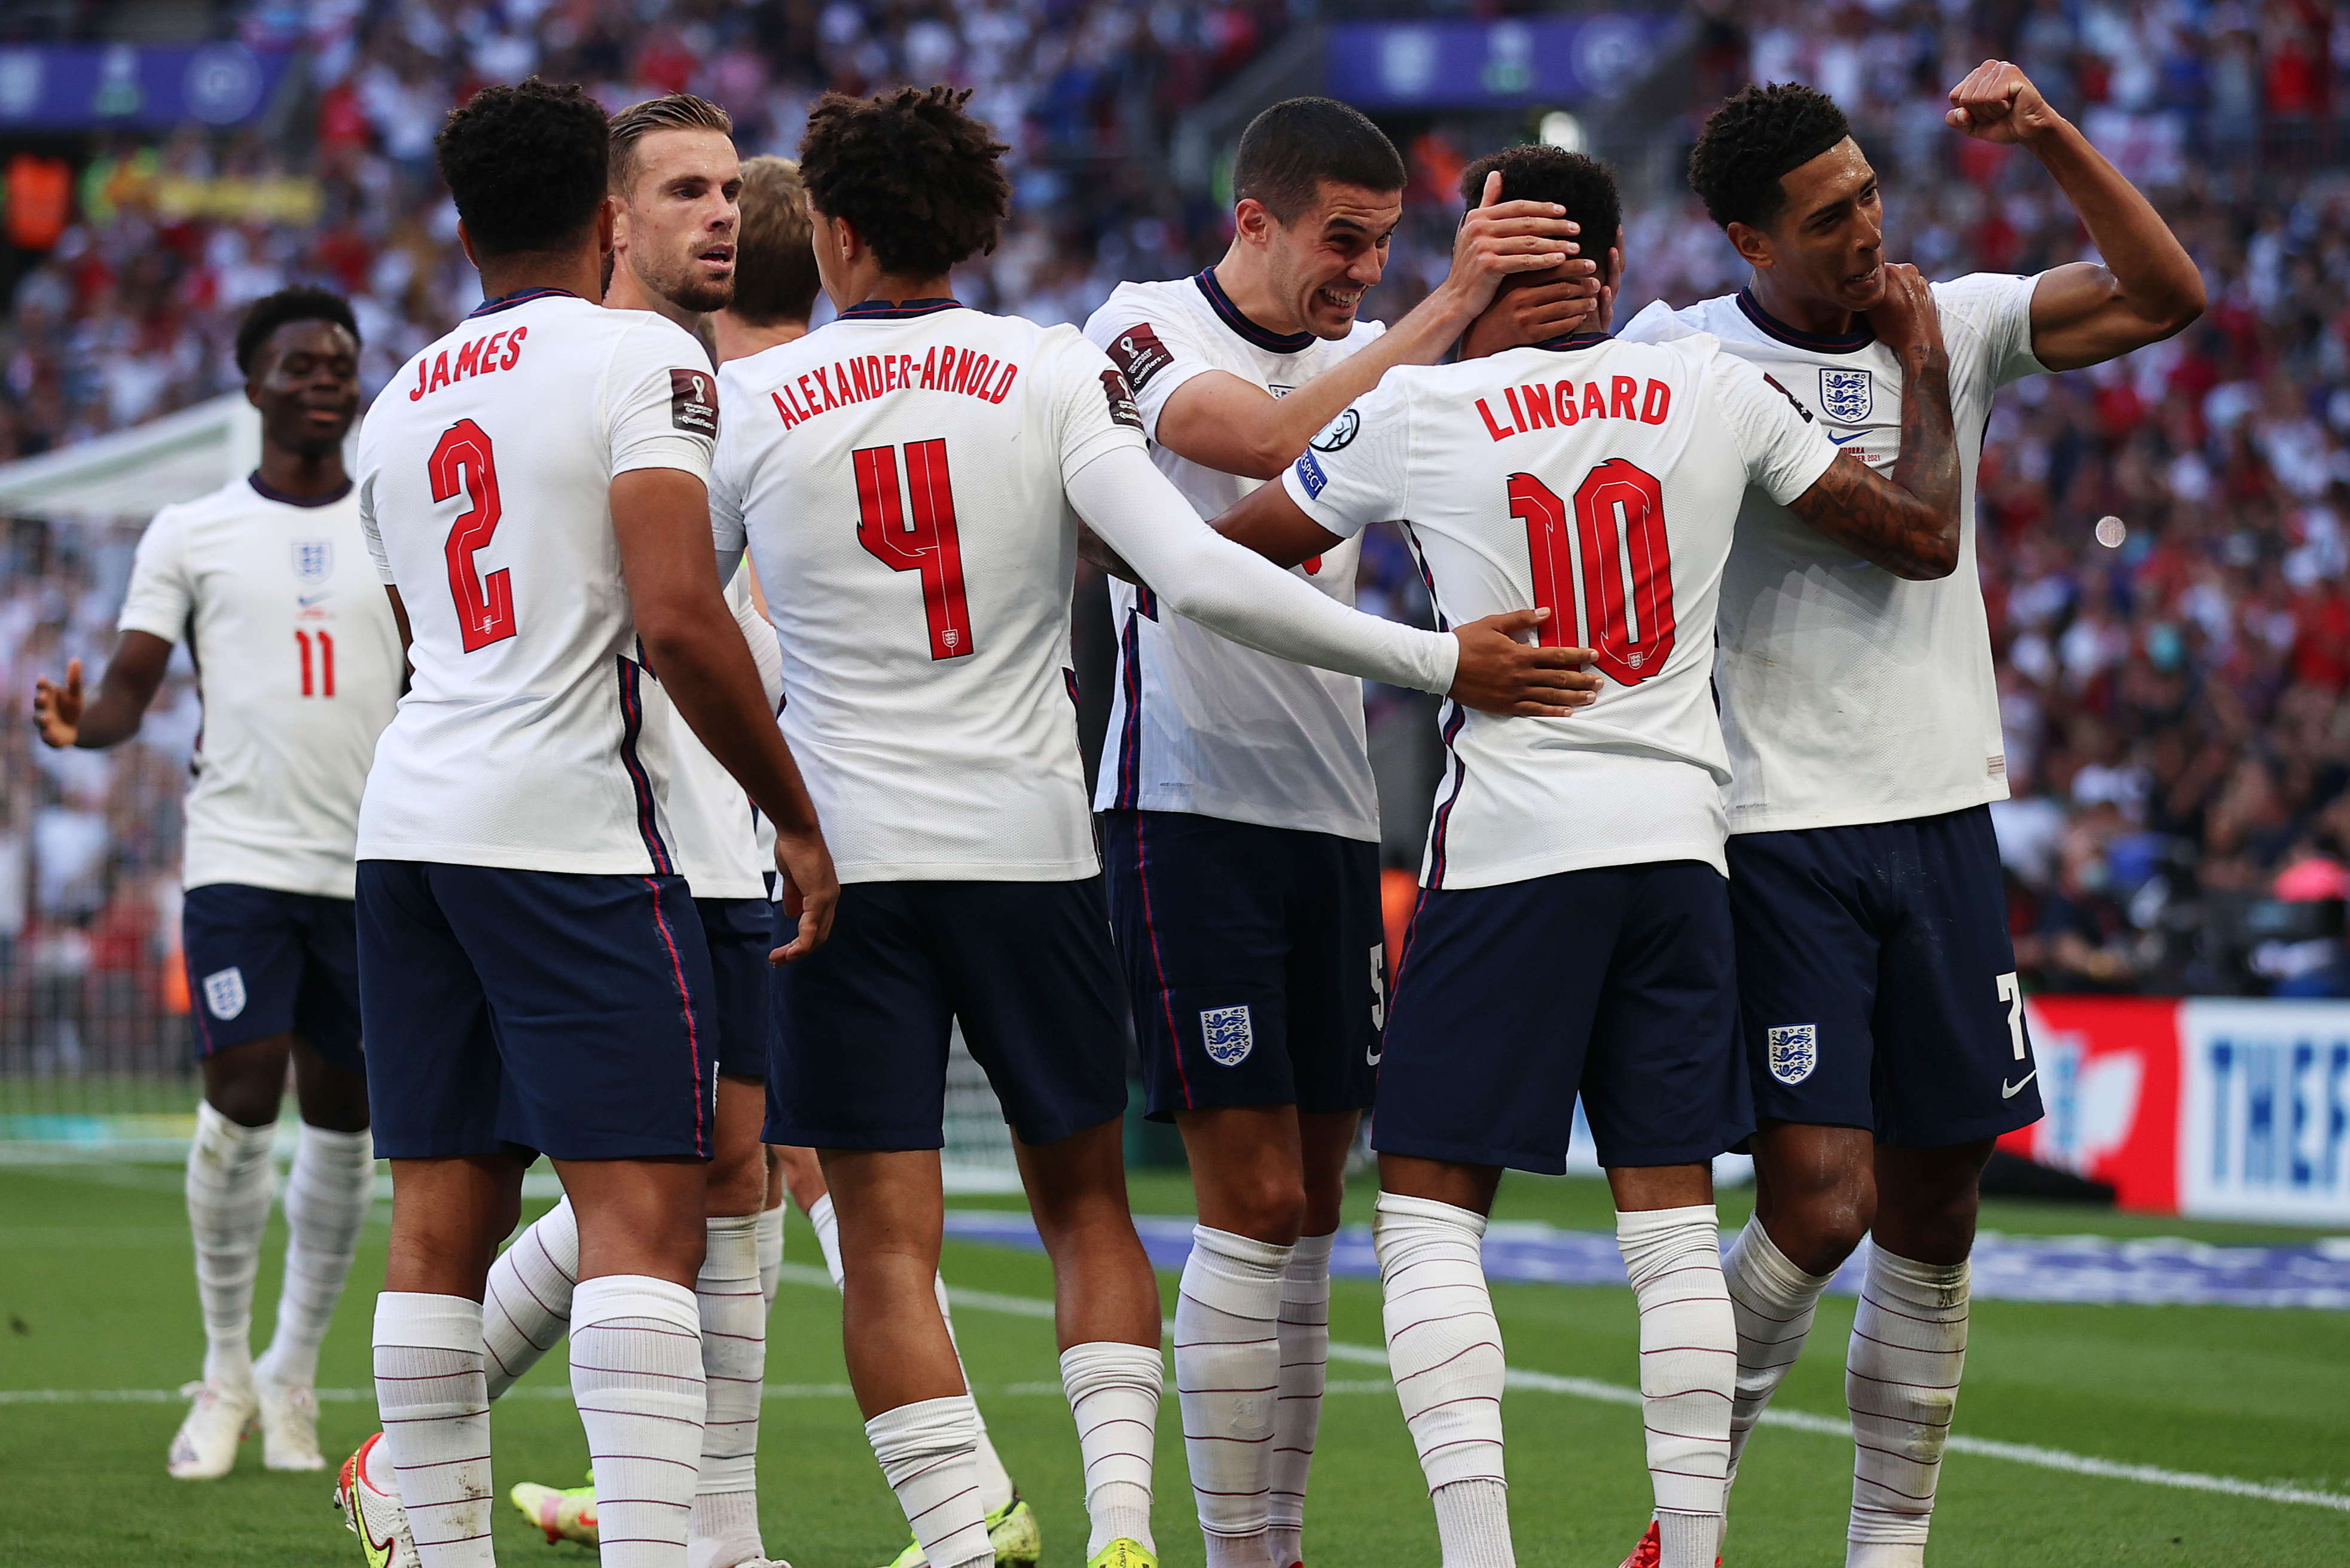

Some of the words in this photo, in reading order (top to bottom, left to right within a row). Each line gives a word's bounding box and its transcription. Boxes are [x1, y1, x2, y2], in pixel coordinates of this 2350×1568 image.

[410, 326, 527, 401] JAMES
[771, 345, 1018, 430] ALEXANDER-ARNOLD
[1134, 356, 1162, 383] Qualifiers
[1475, 376, 1671, 442] LINGARD
[1300, 453, 1323, 492] ESPECT
[428, 419, 517, 653] 2
[852, 438, 973, 660] 4
[1507, 457, 1675, 687] 10
[295, 629, 335, 698] 11
[1369, 942, 1385, 1032] 5
[1996, 971, 2026, 1061] 7
